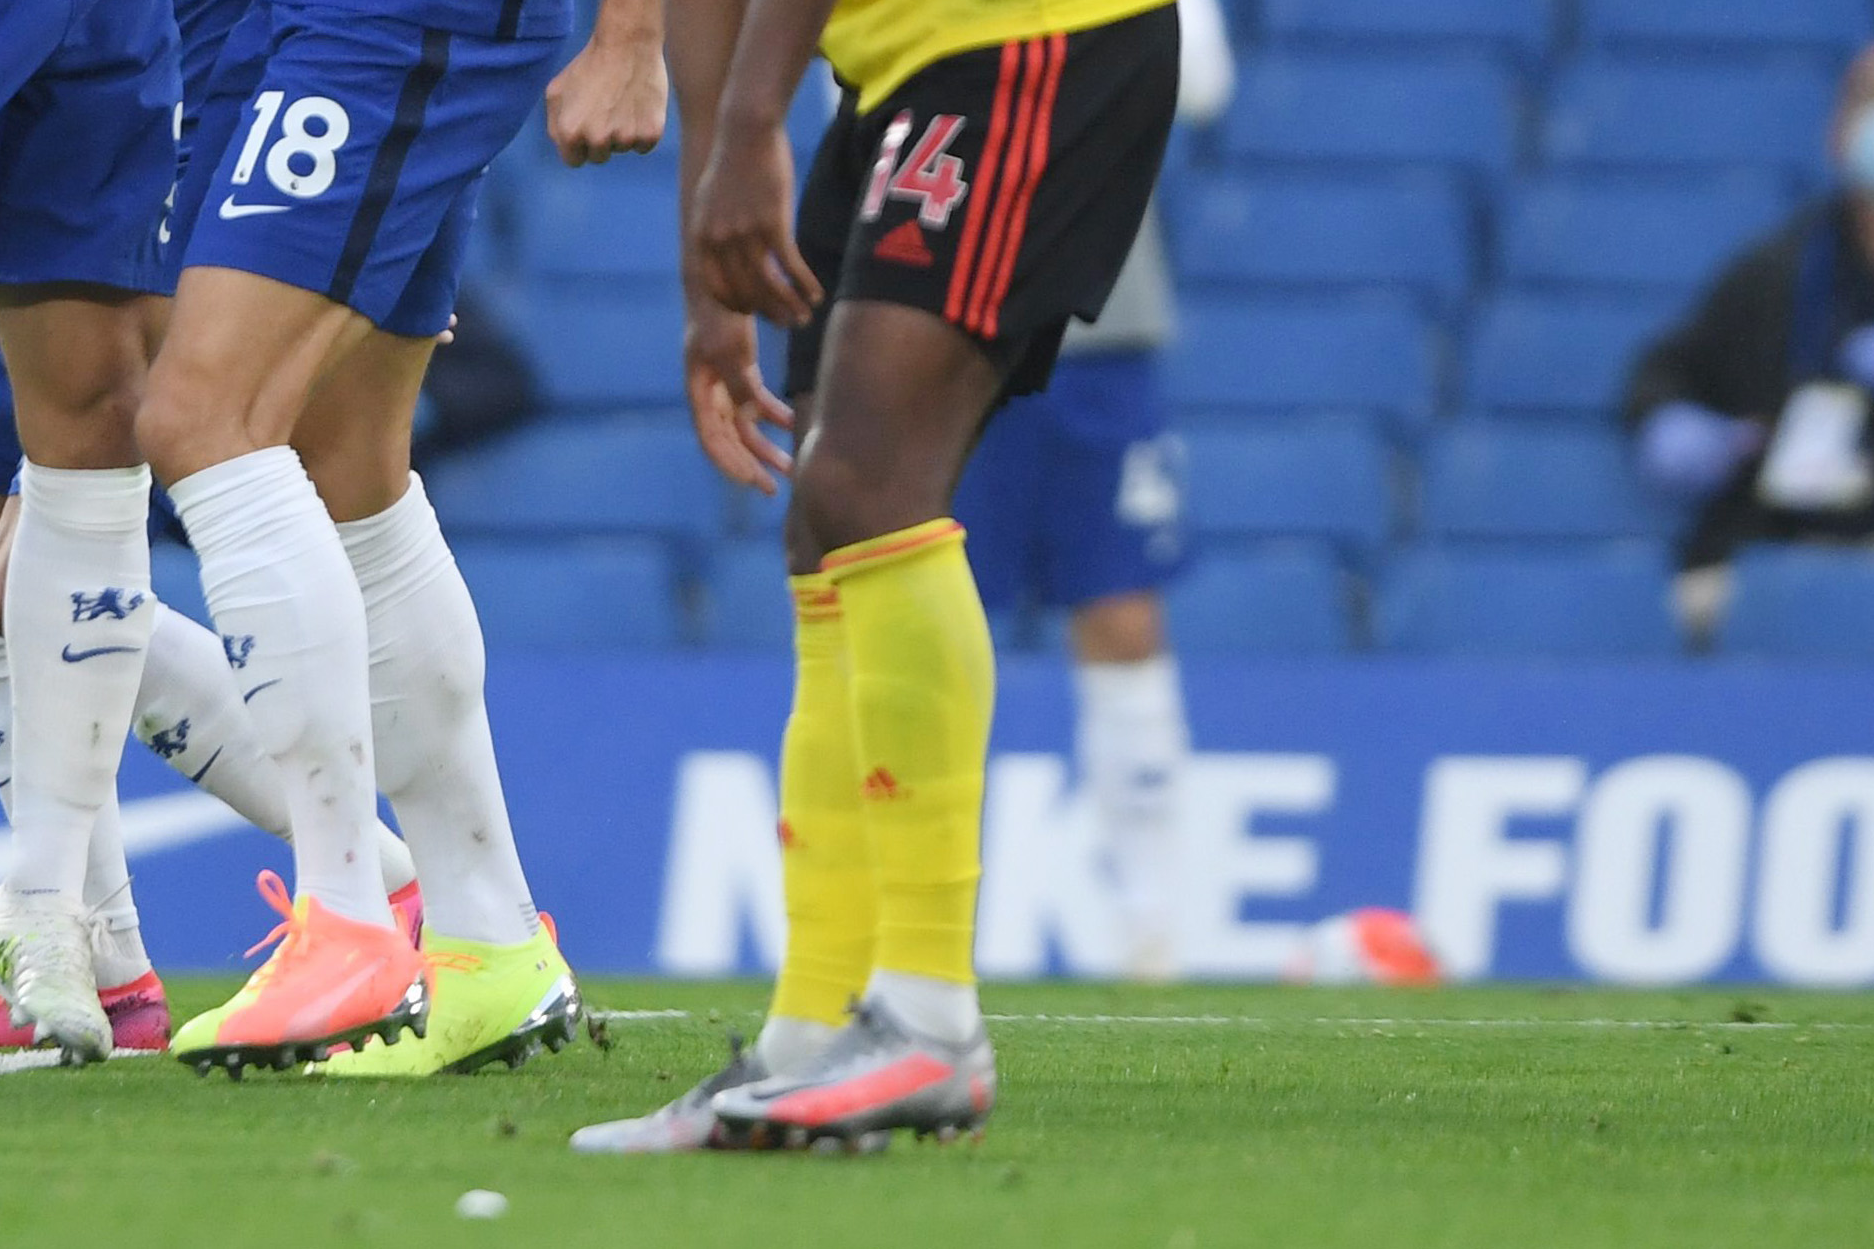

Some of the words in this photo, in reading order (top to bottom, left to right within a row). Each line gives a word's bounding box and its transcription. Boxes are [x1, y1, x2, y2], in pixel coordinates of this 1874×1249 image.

[231, 91, 350, 198] 18
[861, 109, 968, 230] 14
[654, 750, 1338, 980] NKE
[1411, 753, 1874, 983] FOO
